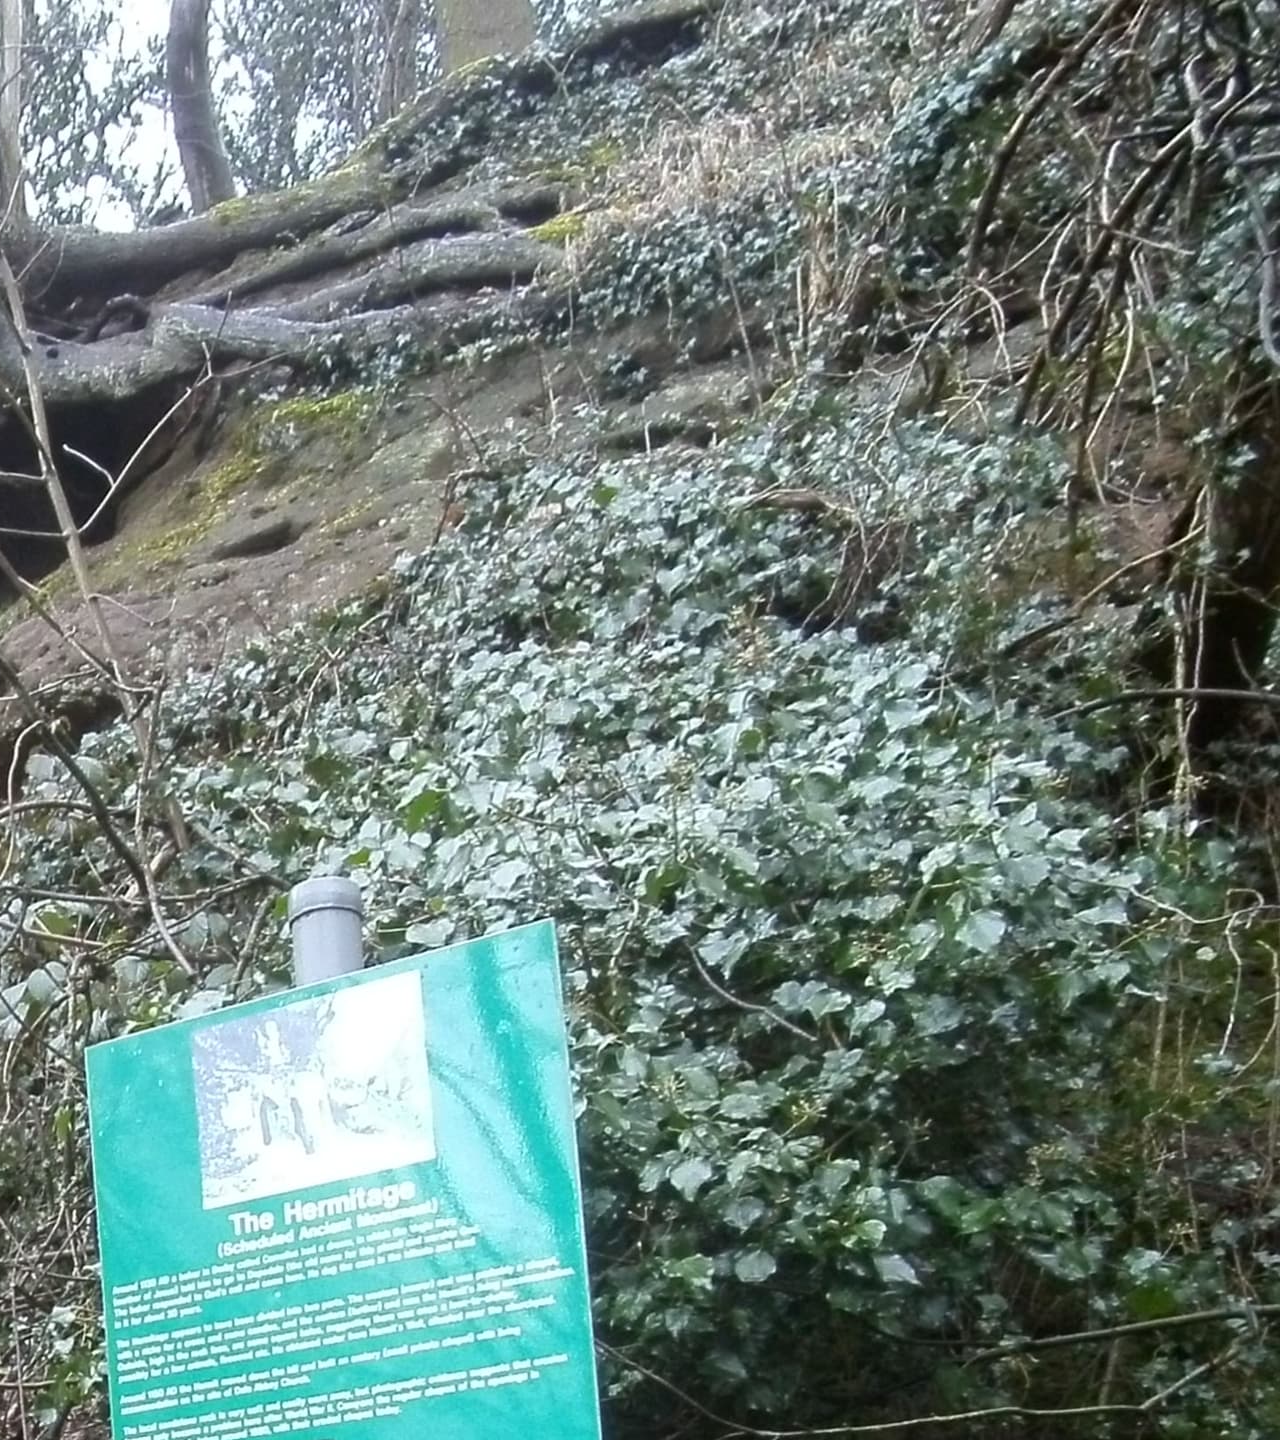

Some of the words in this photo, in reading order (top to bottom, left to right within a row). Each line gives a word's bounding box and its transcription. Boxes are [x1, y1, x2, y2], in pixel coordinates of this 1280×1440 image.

[229, 1211, 274, 1235] The
[284, 1182, 415, 1226] Hermitage
[218, 1232, 293, 1257] (Scheduled
[300, 1218, 352, 1240] Ancient
